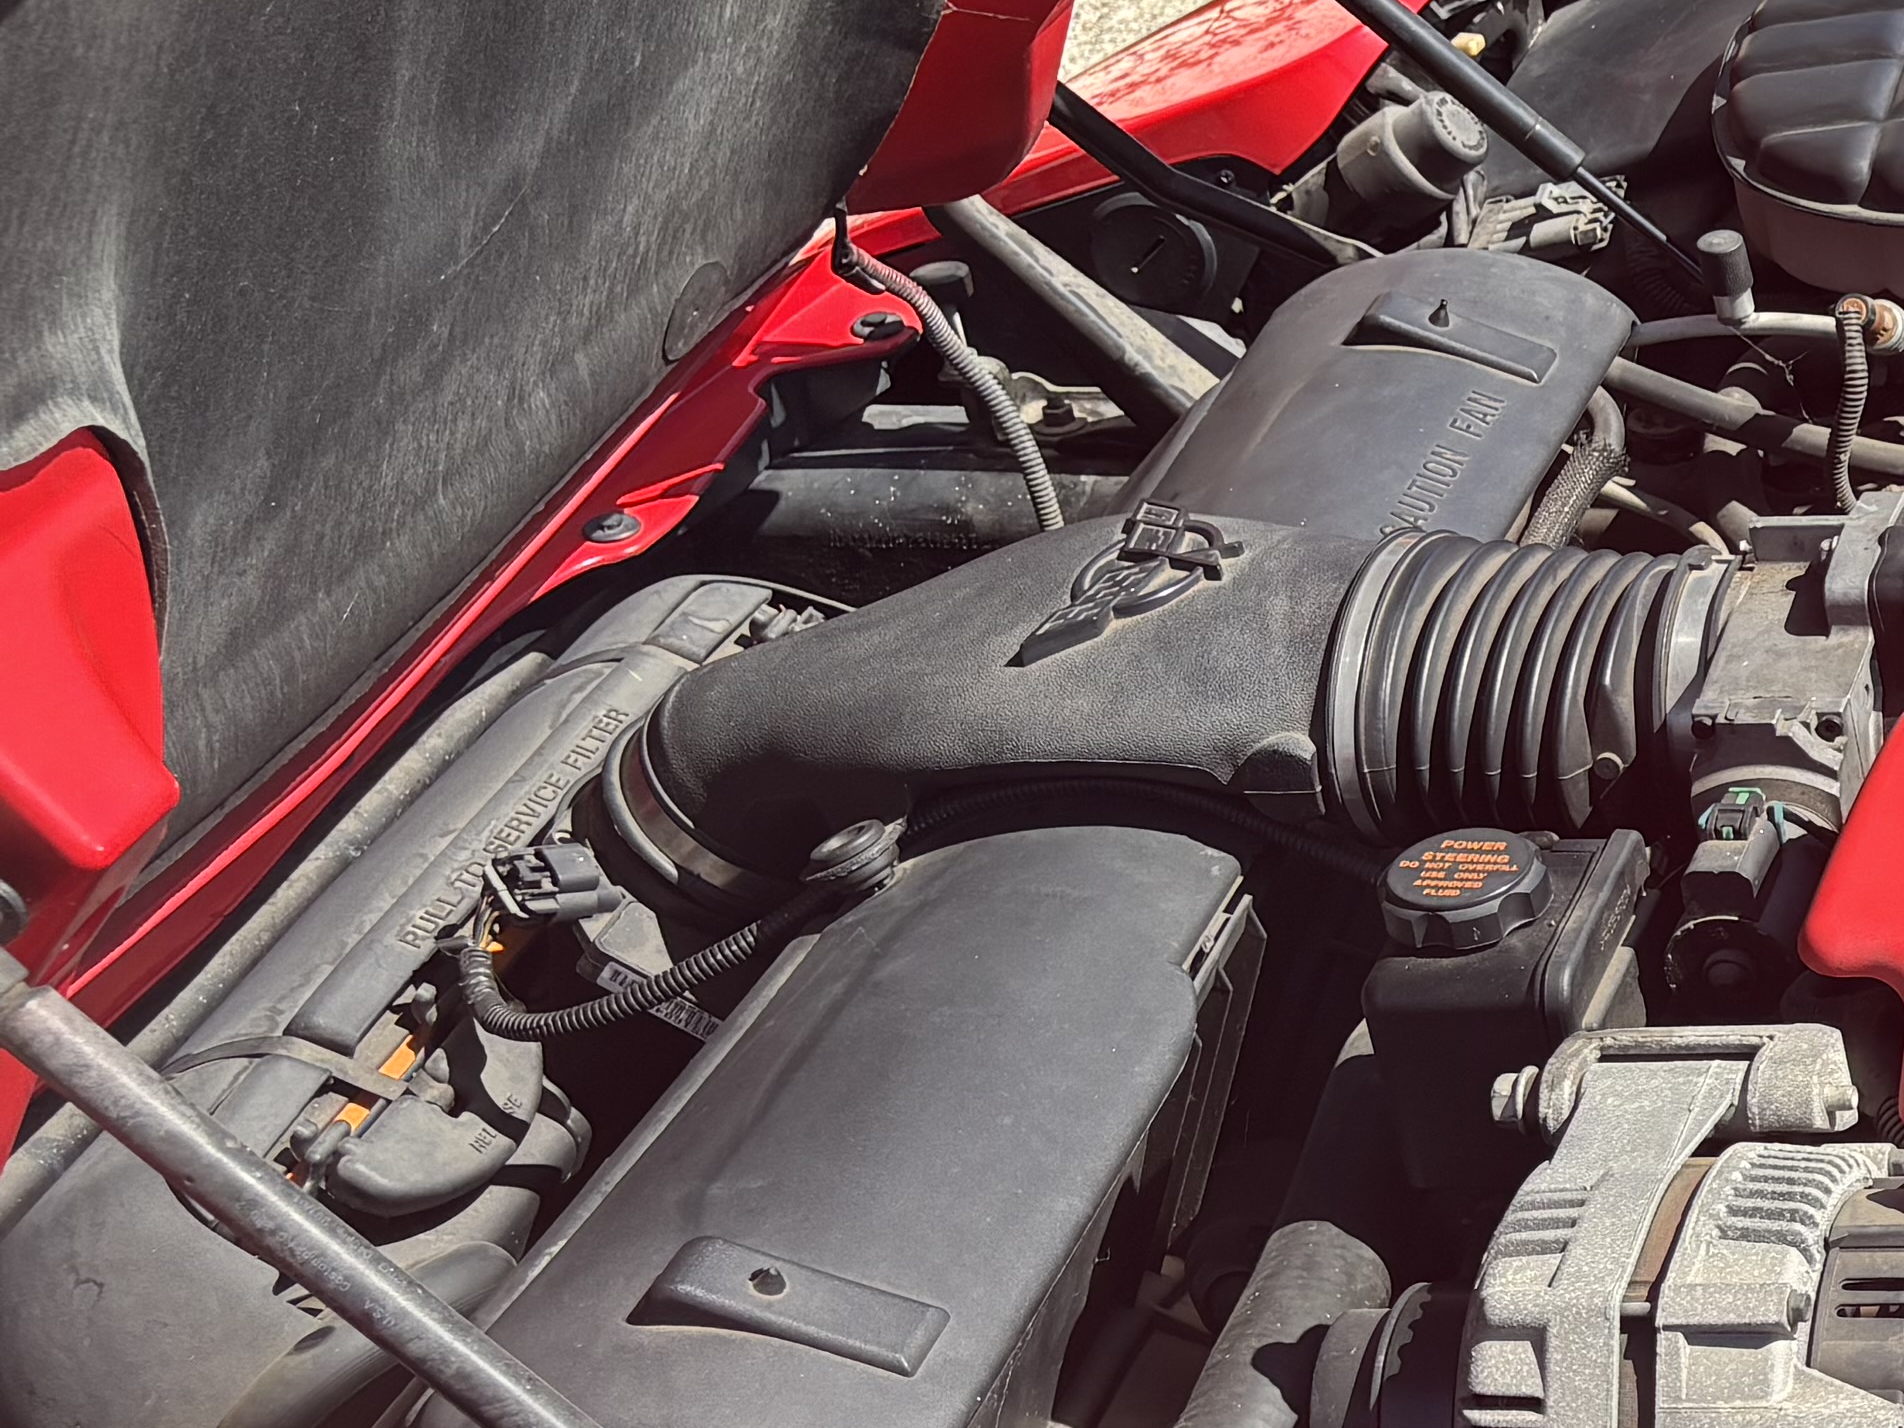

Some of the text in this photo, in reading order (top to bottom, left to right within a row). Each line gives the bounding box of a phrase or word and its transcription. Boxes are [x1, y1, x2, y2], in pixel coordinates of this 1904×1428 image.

[1449, 389, 1509, 439] FAN
[398, 891, 466, 950] PULL
[483, 771, 571, 860] SERVICE
[560, 705, 630, 772] FILTER
[1440, 839, 1508, 851] POWER
[1421, 851, 1511, 864] STEERING
[1399, 859, 1520, 873] DO NOT OVERFILL
[1419, 870, 1488, 881] USE ONLY
[1412, 879, 1484, 890] APPROVED
[1422, 889, 1462, 898] FLUID
